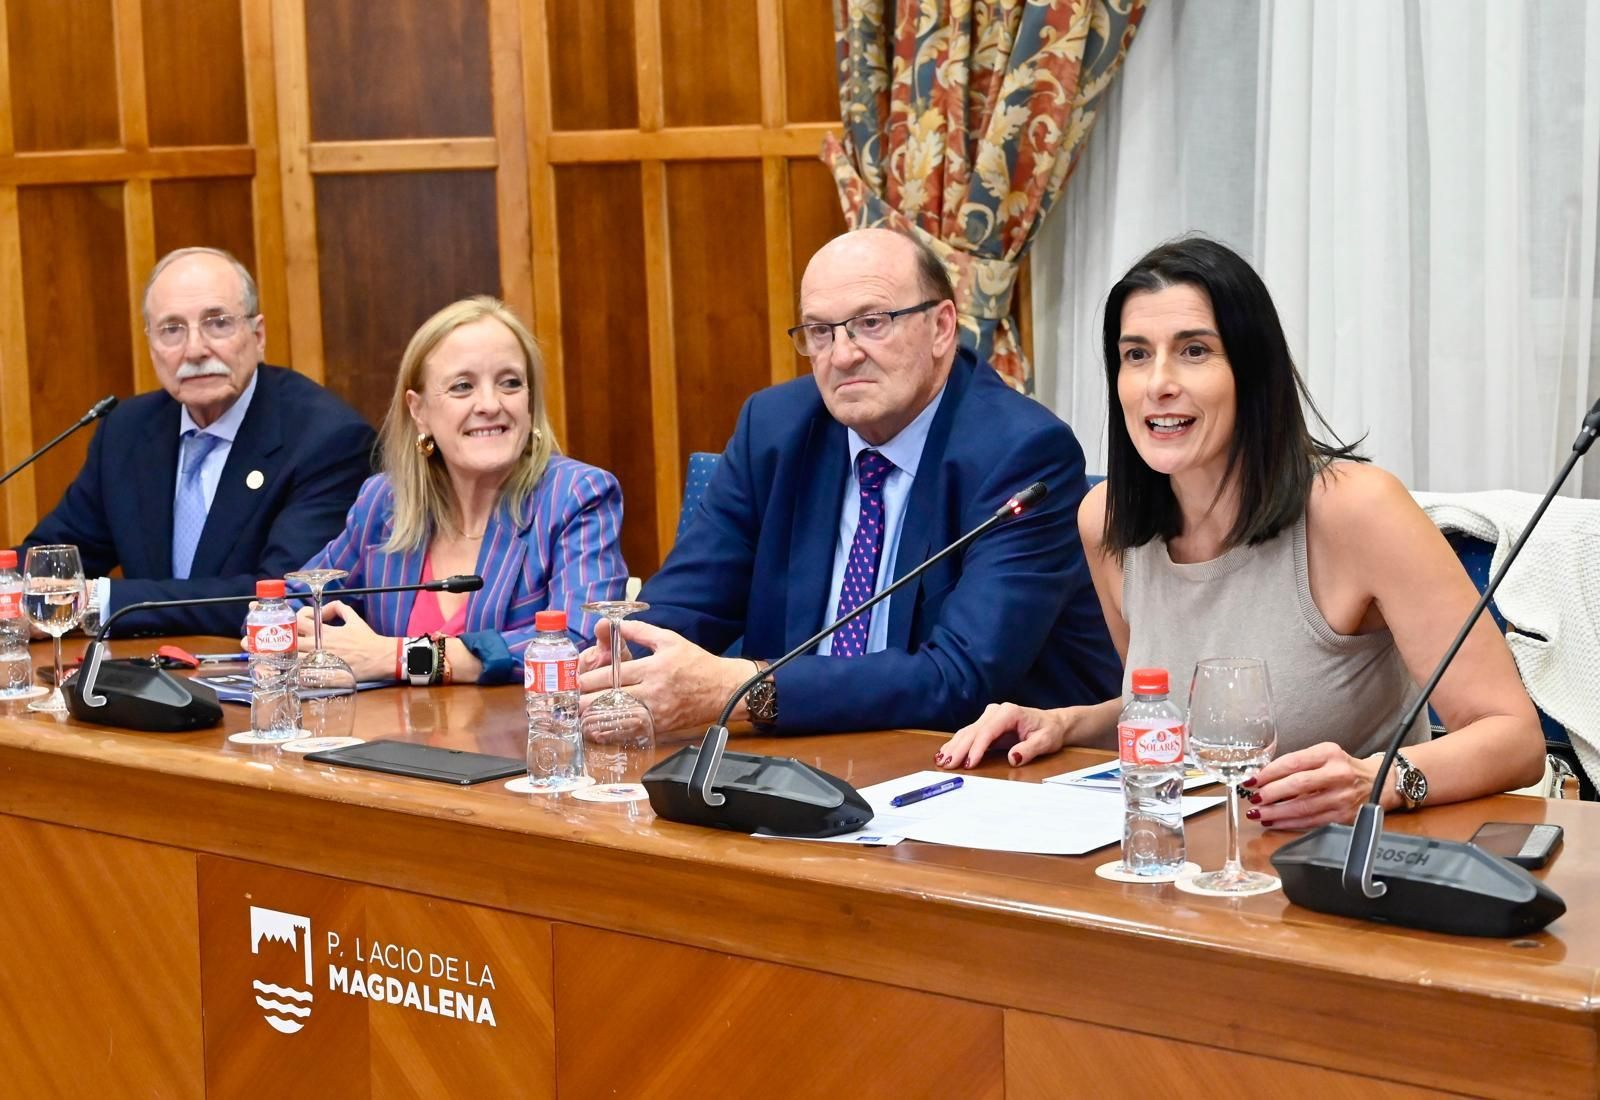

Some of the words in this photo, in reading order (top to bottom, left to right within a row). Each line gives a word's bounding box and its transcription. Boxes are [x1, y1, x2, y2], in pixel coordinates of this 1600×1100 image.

[1139, 739, 1180, 753] SOLARES
[327, 931, 423, 974] PLACIO
[429, 953, 459, 982] DE
[465, 960, 496, 990] LA
[328, 964, 497, 1027] MAGDALENA
